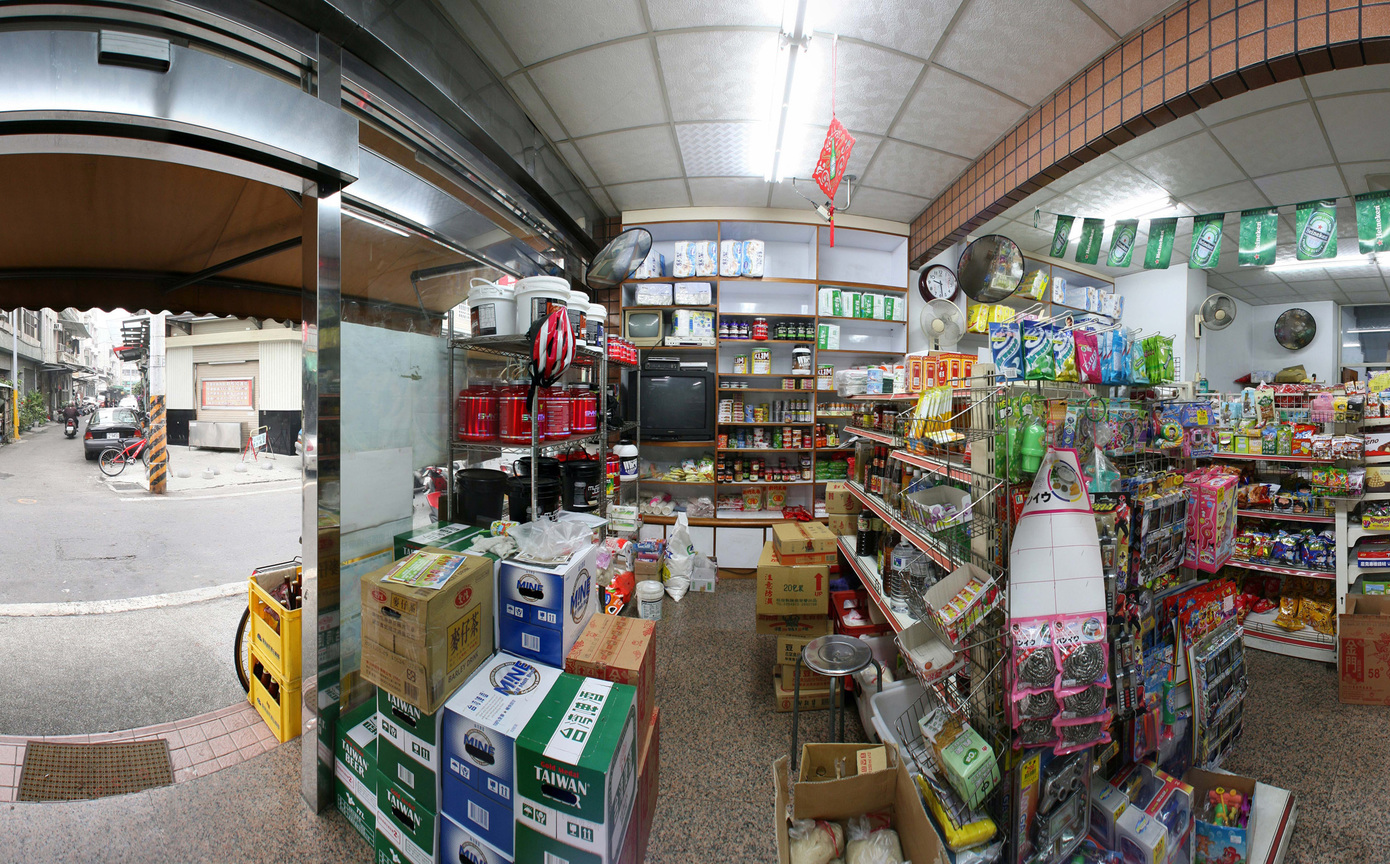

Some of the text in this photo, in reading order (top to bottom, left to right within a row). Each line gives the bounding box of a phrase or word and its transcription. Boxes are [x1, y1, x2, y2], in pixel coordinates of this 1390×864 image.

[1156, 230, 1165, 259] Heineken
[1305, 226, 1330, 241] Heineken
[753, 351, 770, 360] KLIM
[516, 579, 544, 592] MINE
[570, 576, 591, 615] MINE
[450, 610, 480, 656] 麥仔茶
[448, 651, 479, 684] BARLEY DRINK
[1345, 639, 1358, 675] 金門
[494, 660, 534, 697] MINE
[387, 692, 422, 721] TAIWAN
[342, 739, 369, 771] TAIWAN
[463, 732, 496, 757] MINE
[344, 754, 365, 779] BEER
[534, 765, 589, 797] TAIWAN
[540, 760, 580, 779] Gold Medal
[386, 788, 422, 827] TAIWAN
[458, 844, 488, 864] MIN
